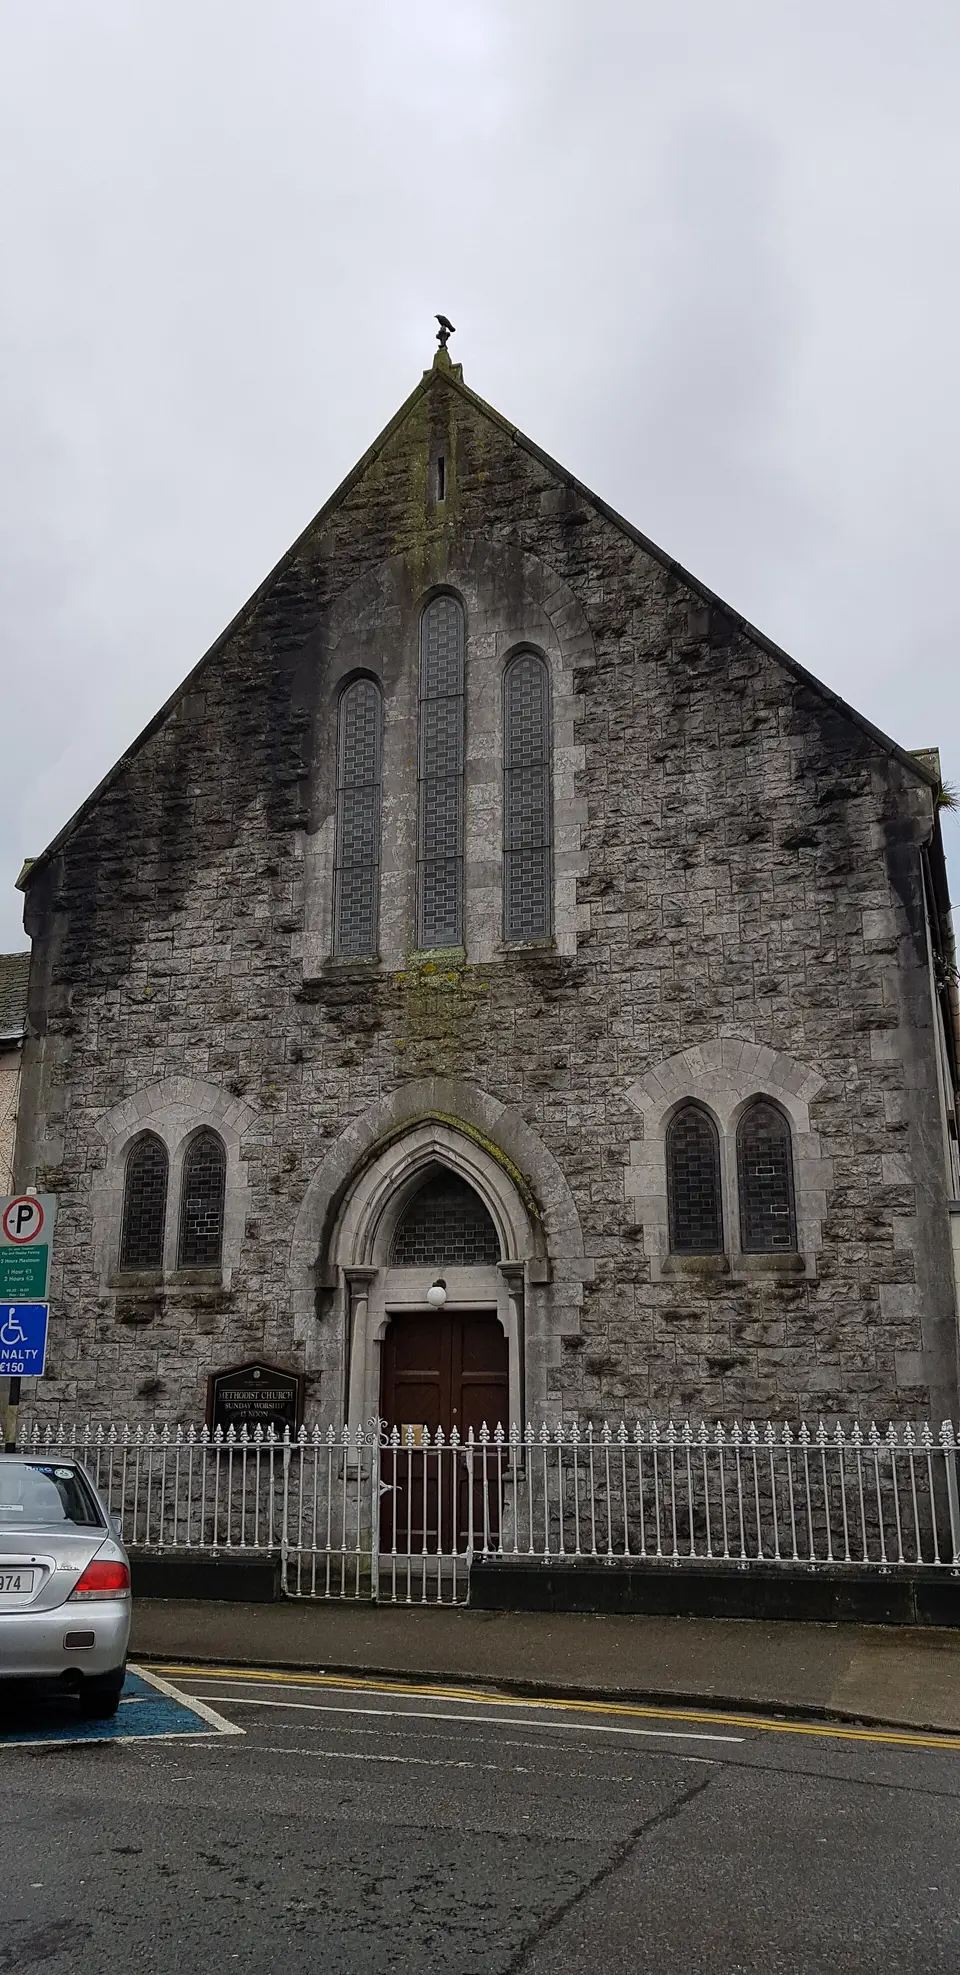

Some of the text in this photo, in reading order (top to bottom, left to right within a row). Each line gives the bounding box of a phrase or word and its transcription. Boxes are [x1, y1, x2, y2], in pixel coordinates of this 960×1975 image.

[16, 1204, 34, 1234] P
[0, 1362, 24, 1373] €150
[218, 1391, 293, 1400] METHODIST CHURCH
[225, 1402, 285, 1410] SUNDAY WORSHIP
[248, 1410, 269, 1418] NOON
